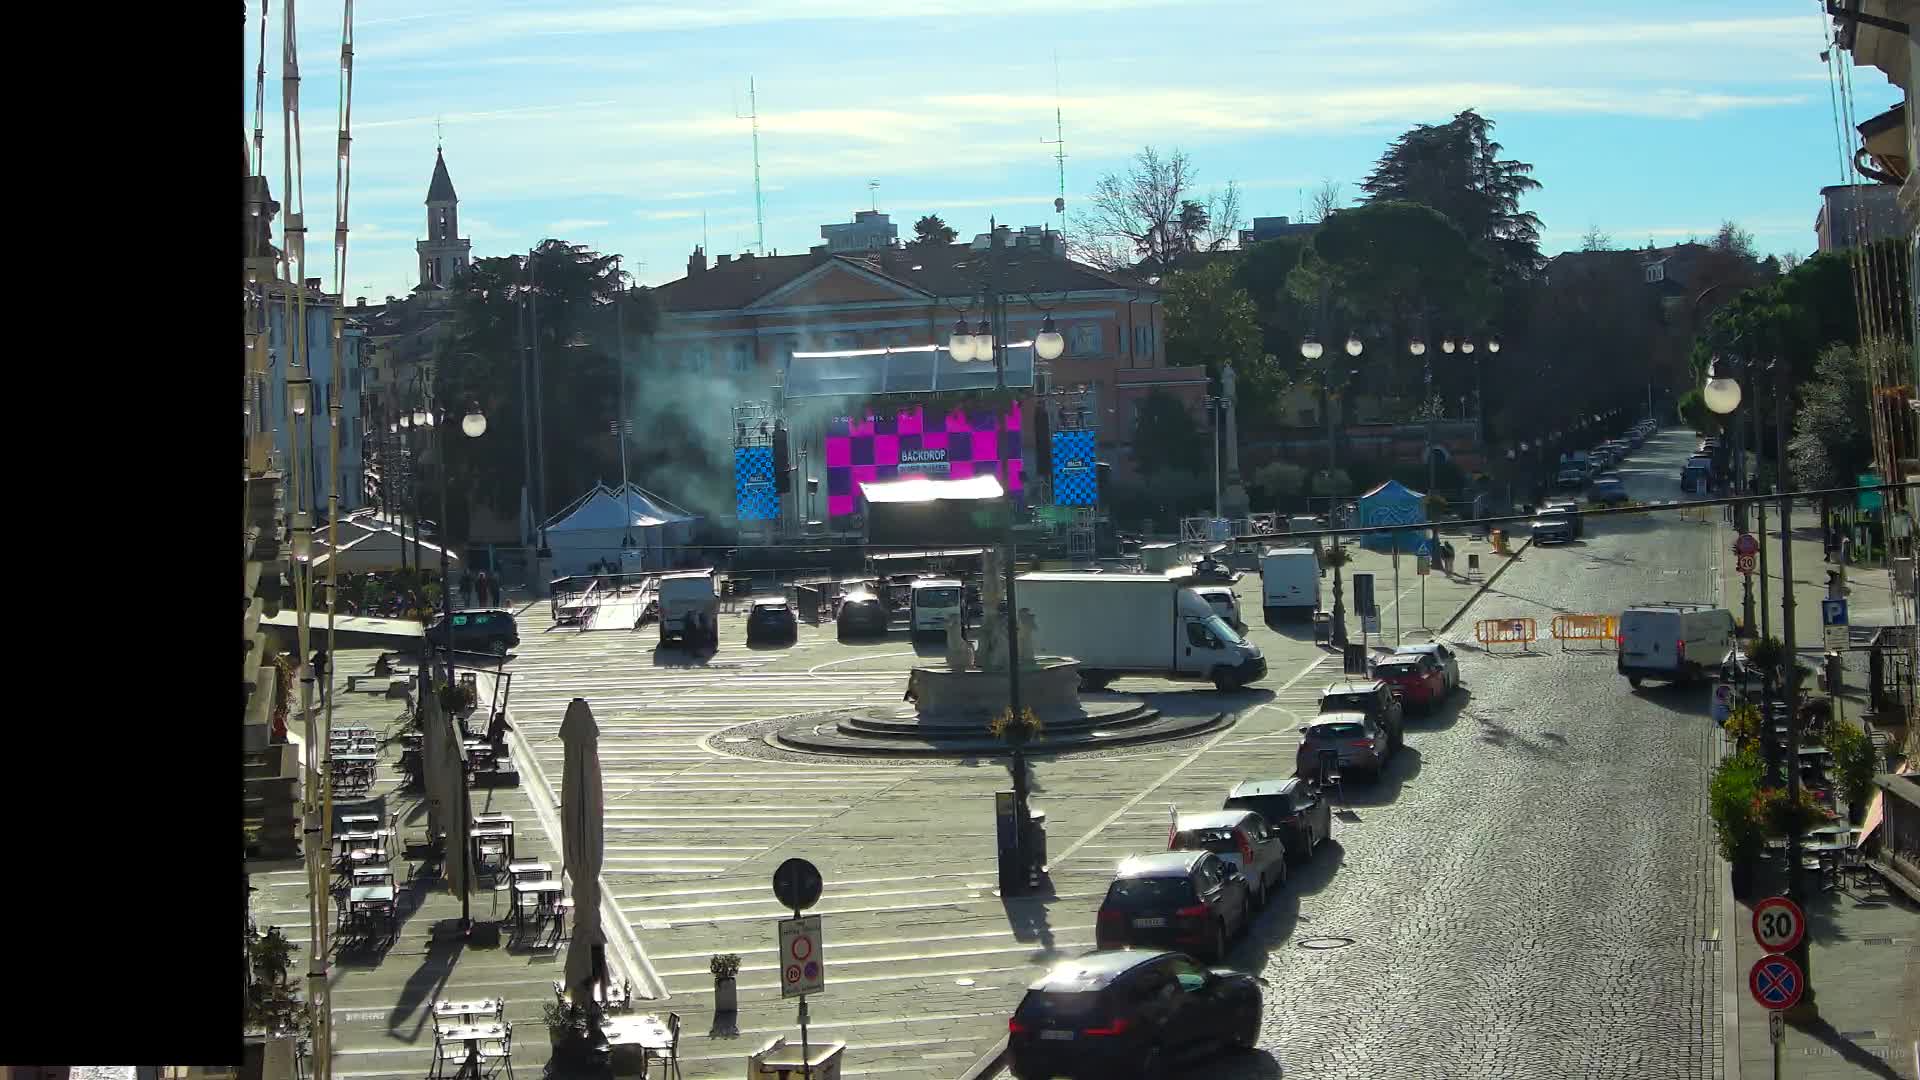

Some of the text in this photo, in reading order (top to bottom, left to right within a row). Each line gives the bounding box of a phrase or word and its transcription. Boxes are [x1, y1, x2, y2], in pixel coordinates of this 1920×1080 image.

[901, 448, 946, 462] BACKDROP
[1827, 602, 1842, 621] P
[1762, 913, 1792, 938] 30
